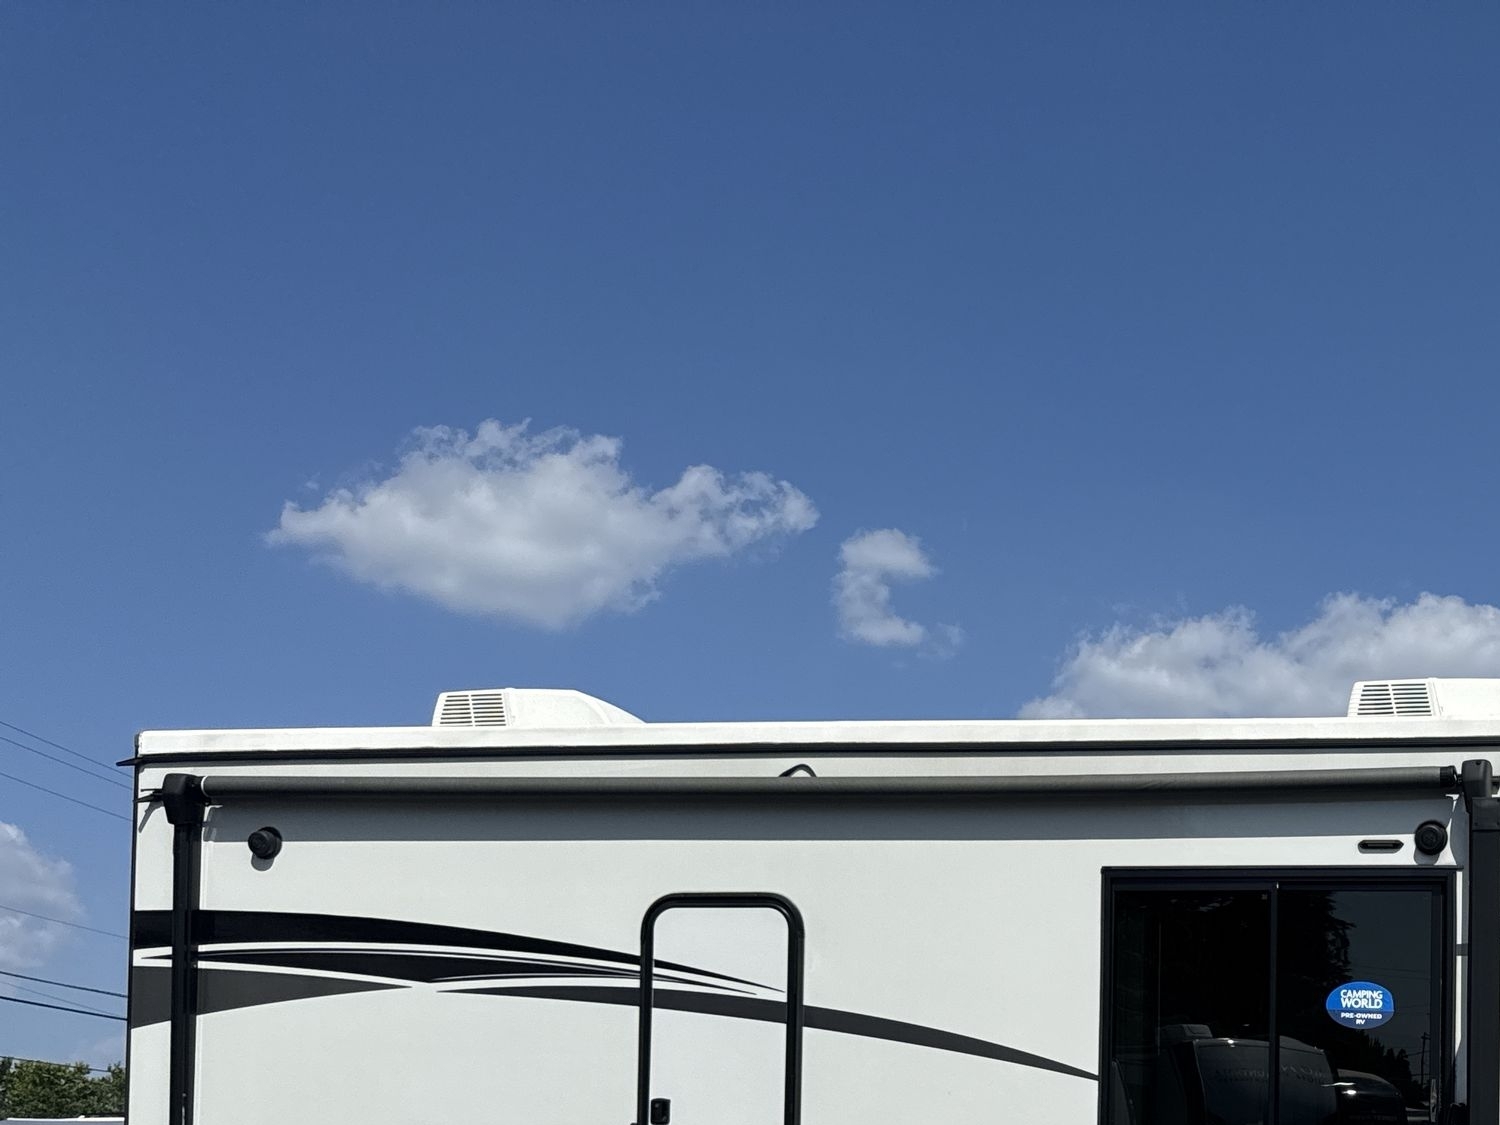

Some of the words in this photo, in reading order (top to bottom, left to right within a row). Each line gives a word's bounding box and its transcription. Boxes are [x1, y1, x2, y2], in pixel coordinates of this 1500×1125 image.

[1340, 989, 1383, 999] CAMPING
[1341, 998, 1383, 1009] WORLD
[1340, 1012, 1382, 1020] PRE-OWNED
